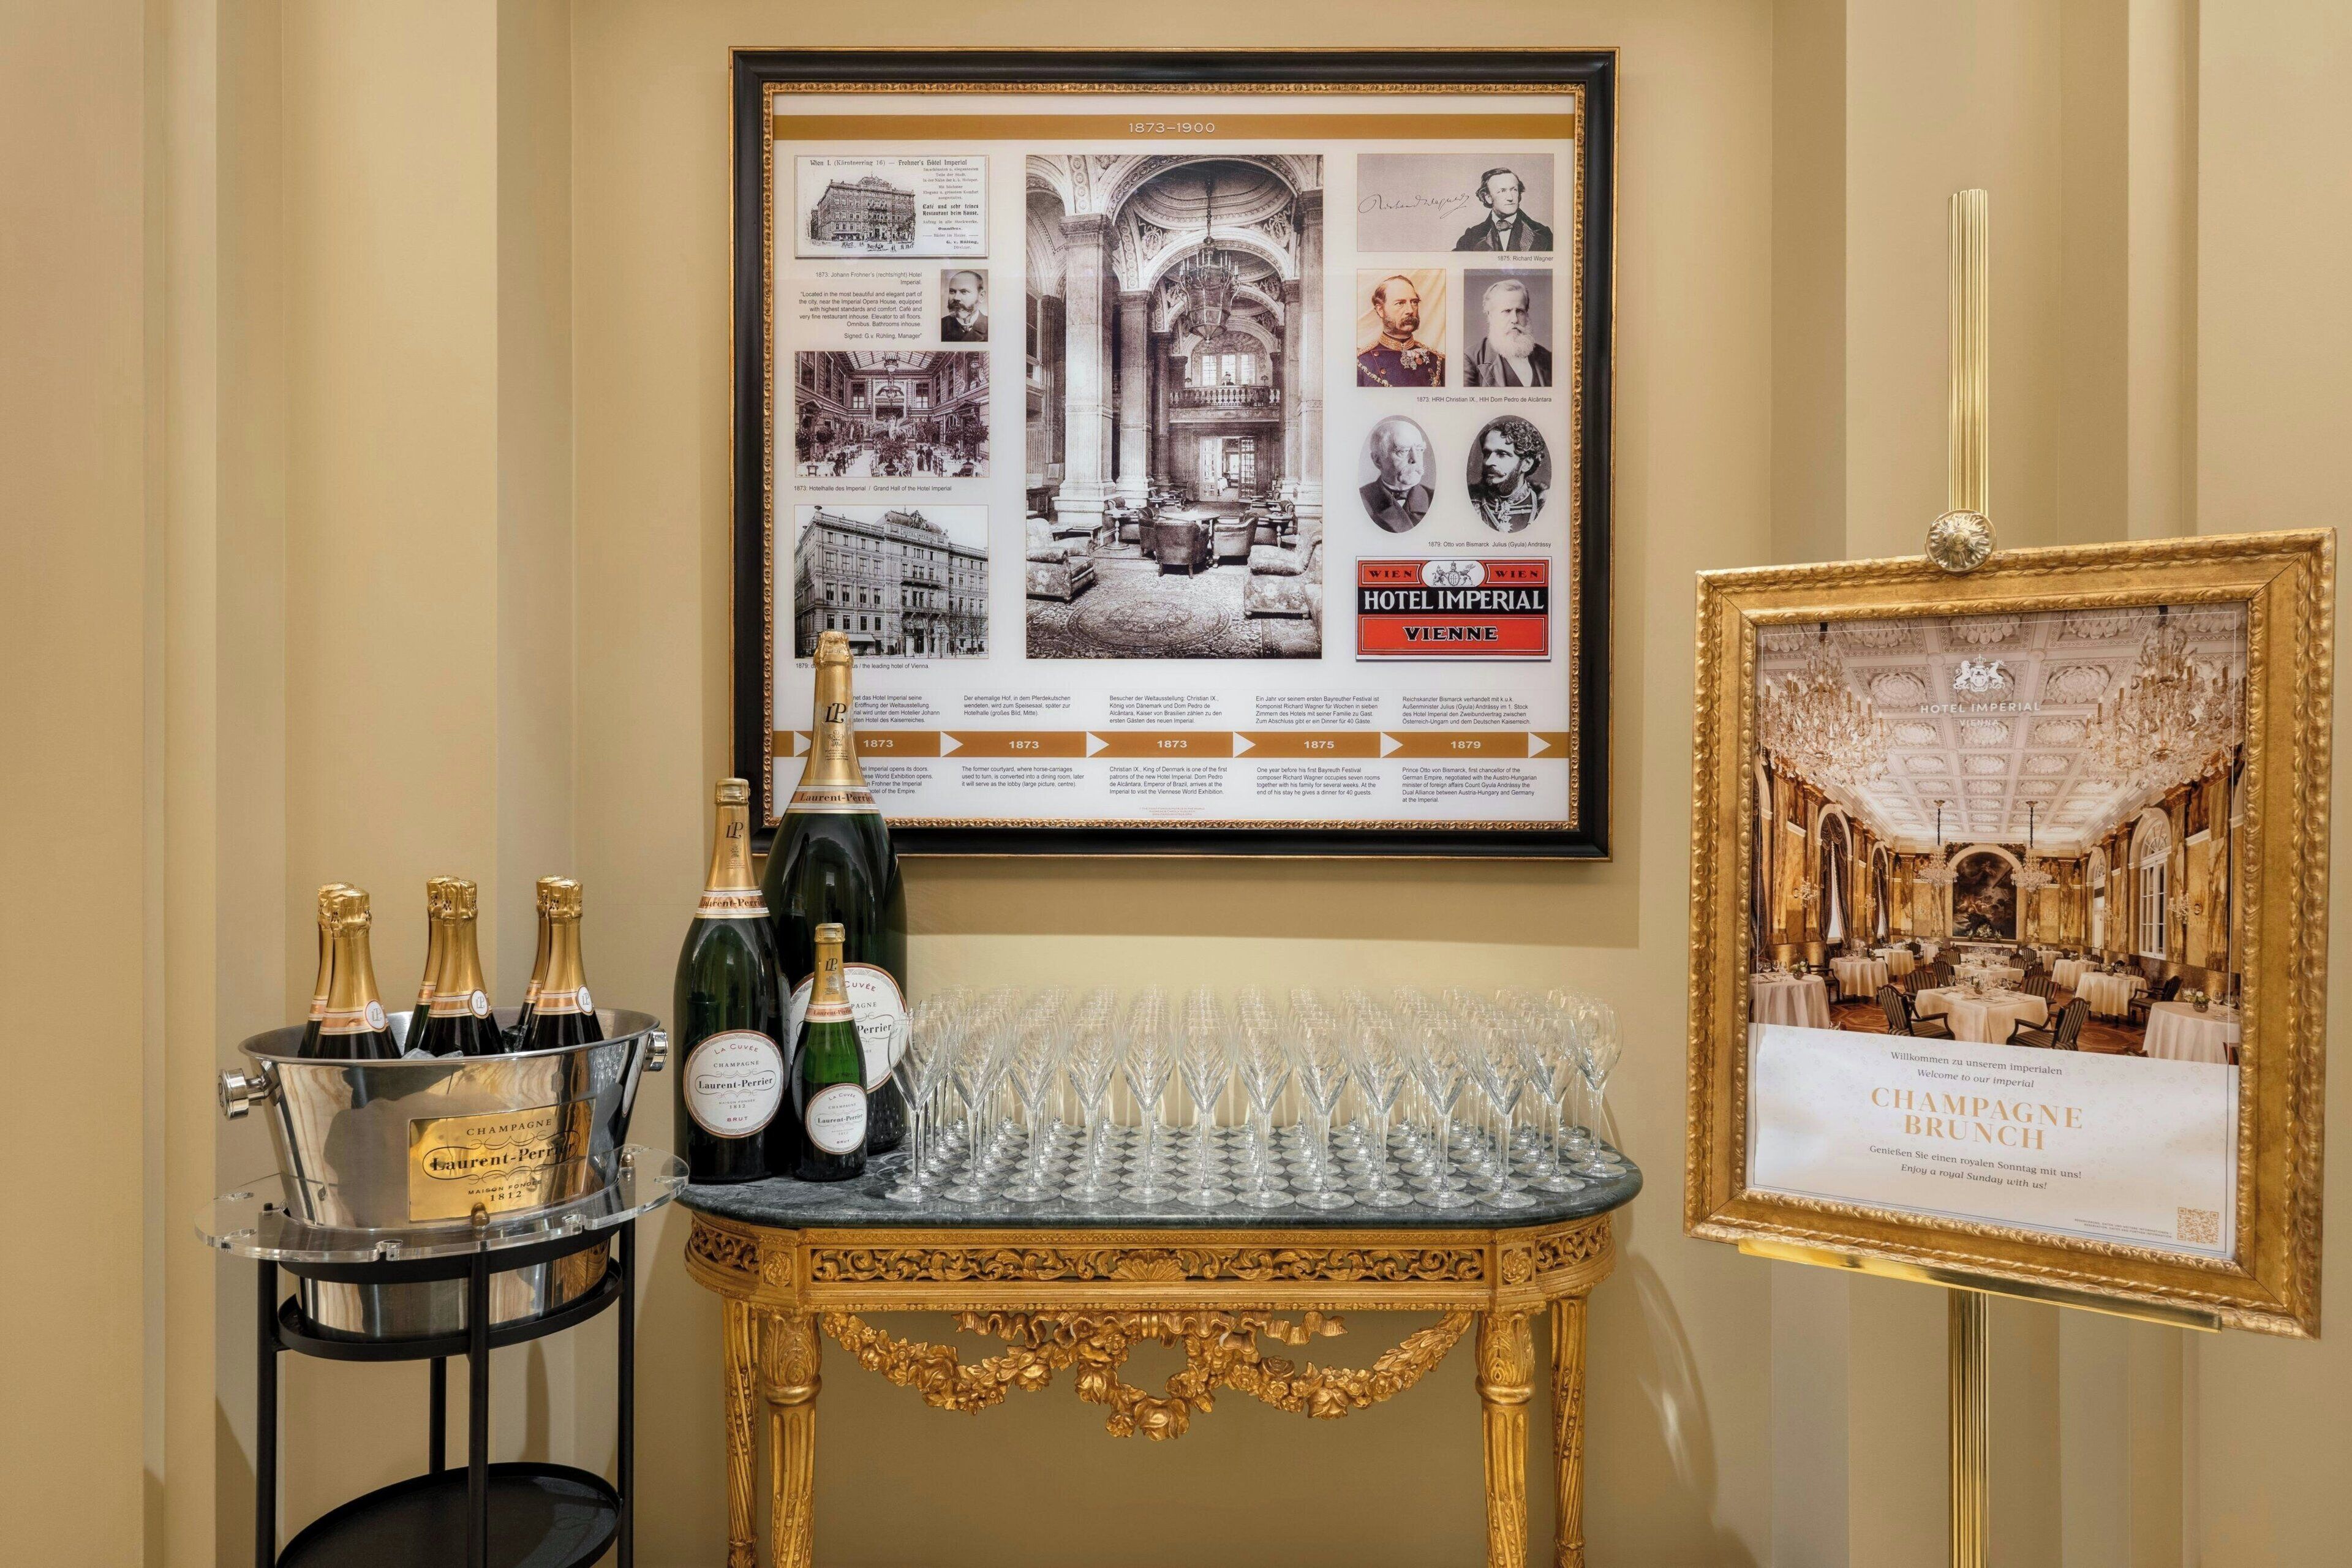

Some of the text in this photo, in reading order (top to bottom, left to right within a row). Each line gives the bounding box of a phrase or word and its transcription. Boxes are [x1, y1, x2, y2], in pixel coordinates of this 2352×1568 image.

[1129, 123, 1215, 132] 1873–1900
[1364, 590, 1544, 611] HOTEL IMPERIAL
[1403, 626, 1499, 641] VIENNE
[1920, 703, 2040, 713] HOTEL IMPERIAL
[729, 1043, 759, 1052] CUVÉE
[1891, 1052, 1948, 1064] Willkommen
[1966, 1060, 2006, 1069] unserem
[2010, 1063, 2062, 1075] imperialen
[698, 1077, 773, 1089] Laurent-Perrier
[1917, 1069, 1958, 1080] Welcome
[1993, 1077, 2034, 1087] imperial
[1871, 1087, 2082, 1129] CHAMPAGNE
[466, 1118, 552, 1136] CHAMPAGNE
[818, 1114, 863, 1123] Laurent-Perrier
[1904, 1114, 2045, 1150] BRUNCH
[431, 1142, 576, 1172] Laurent-Perrier
[1869, 1145, 1912, 1157] Genießen
[1915, 1150, 1928, 1159] Sie
[1931, 1153, 1956, 1163] einen
[1960, 1158, 1994, 1168] royalen
[1997, 1161, 2037, 1175] Sonntag
[1901, 1164, 1927, 1175] Enjoy
[1966, 1172, 2003, 1185] Sunday
[2007, 1178, 2029, 1187] with
[467, 1180, 542, 1195] MAISON FONDÉE
[490, 1191, 522, 1202] 1812
